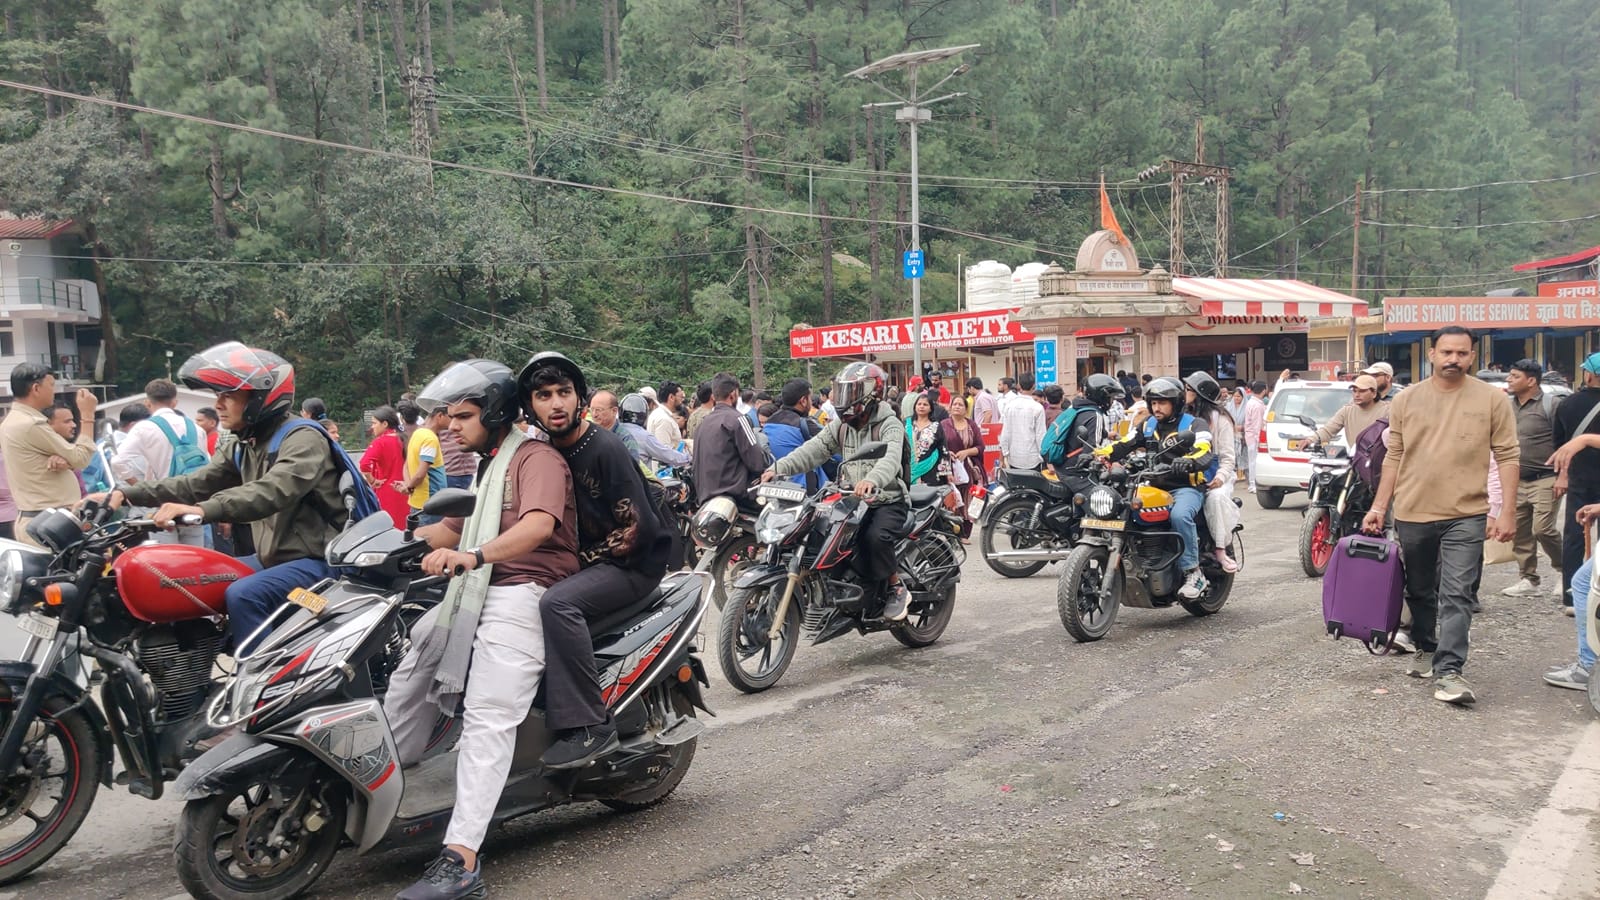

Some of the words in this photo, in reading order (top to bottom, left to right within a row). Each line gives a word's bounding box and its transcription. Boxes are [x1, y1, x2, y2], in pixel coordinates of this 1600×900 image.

[907, 258, 920, 267] Entry
[1388, 304, 1418, 323] SHOE
[1422, 304, 1456, 322] STAND
[1460, 304, 1486, 322] FREE
[1488, 303, 1529, 321] SERVICE
[821, 324, 900, 349] KESARI
[904, 314, 1009, 342] VARIETY
[963, 335, 1014, 346] DISTRIBUTOR
[624, 611, 664, 637] NTORQ
[647, 765, 660, 774] TVS
